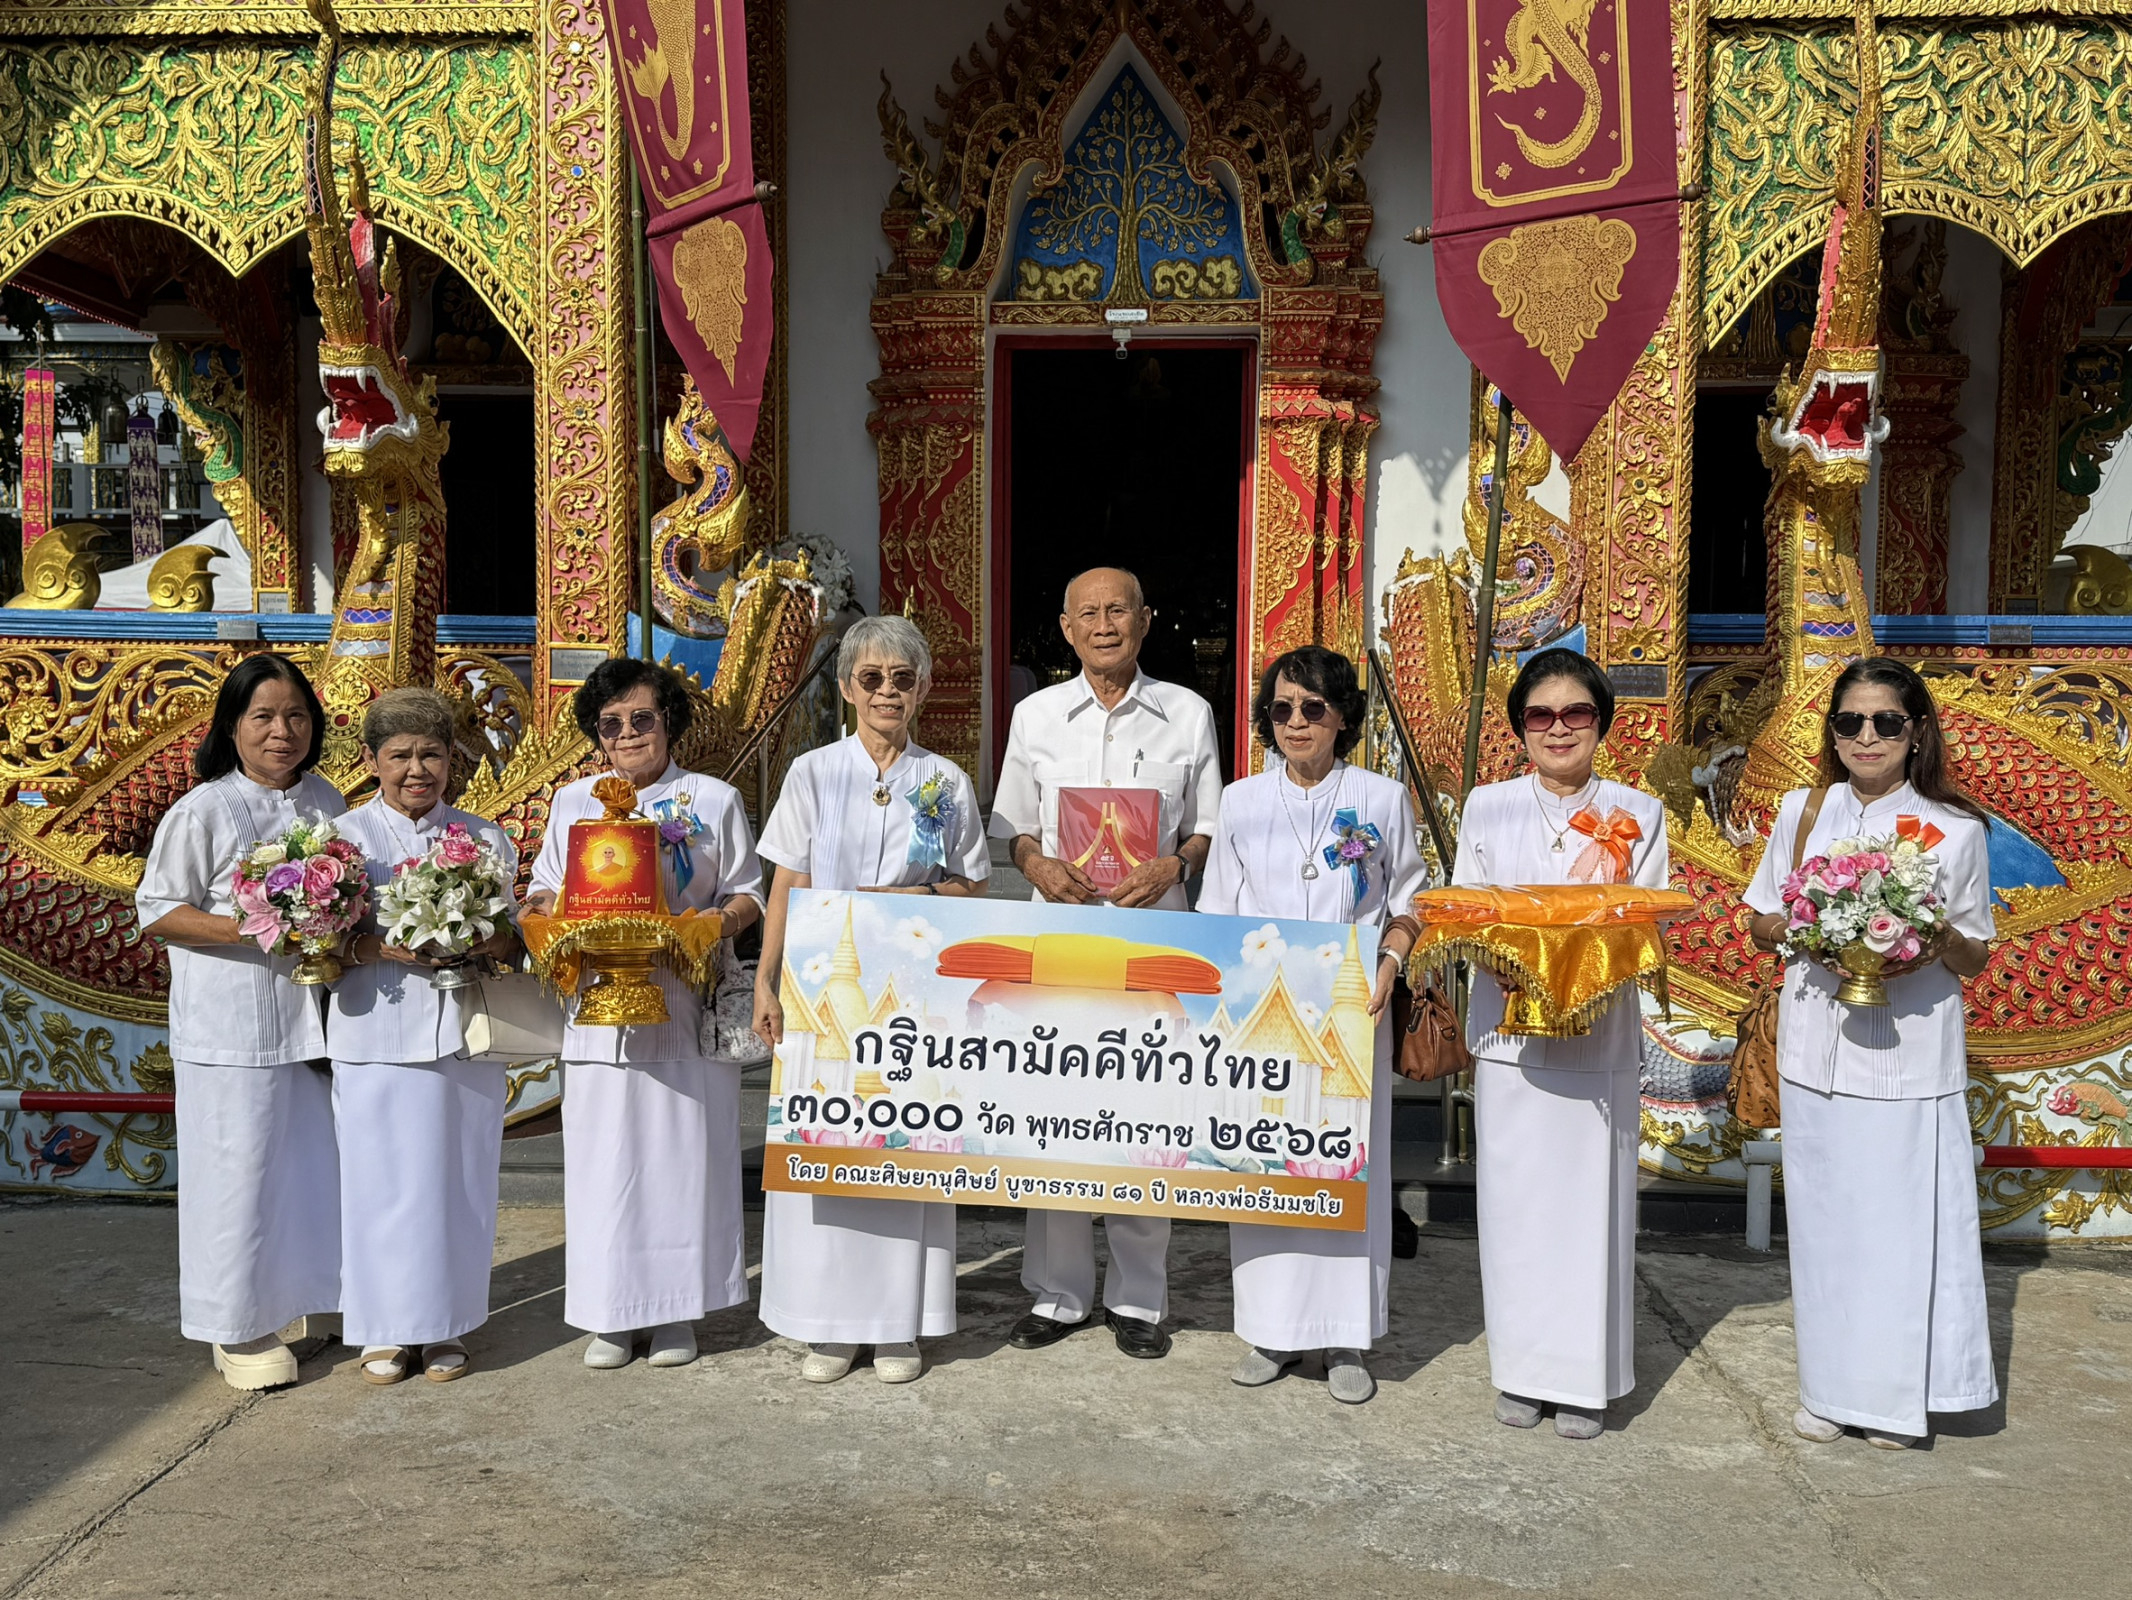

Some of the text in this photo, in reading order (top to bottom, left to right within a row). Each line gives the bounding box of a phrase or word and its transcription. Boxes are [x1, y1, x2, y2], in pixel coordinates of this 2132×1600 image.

[855, 1016, 1291, 1092] กฐินสามัคคีทั่วไทย
[787, 1094, 1352, 1160] ๓๐,๐๐๐ วัด พุทธศักราช ๒๕๖๘
[788, 1156, 1341, 1215] โดย คณะศิษยานุศิษย์ บูชาธรรม ๘๑ ปี หลวงพ่อธัมมชโย
